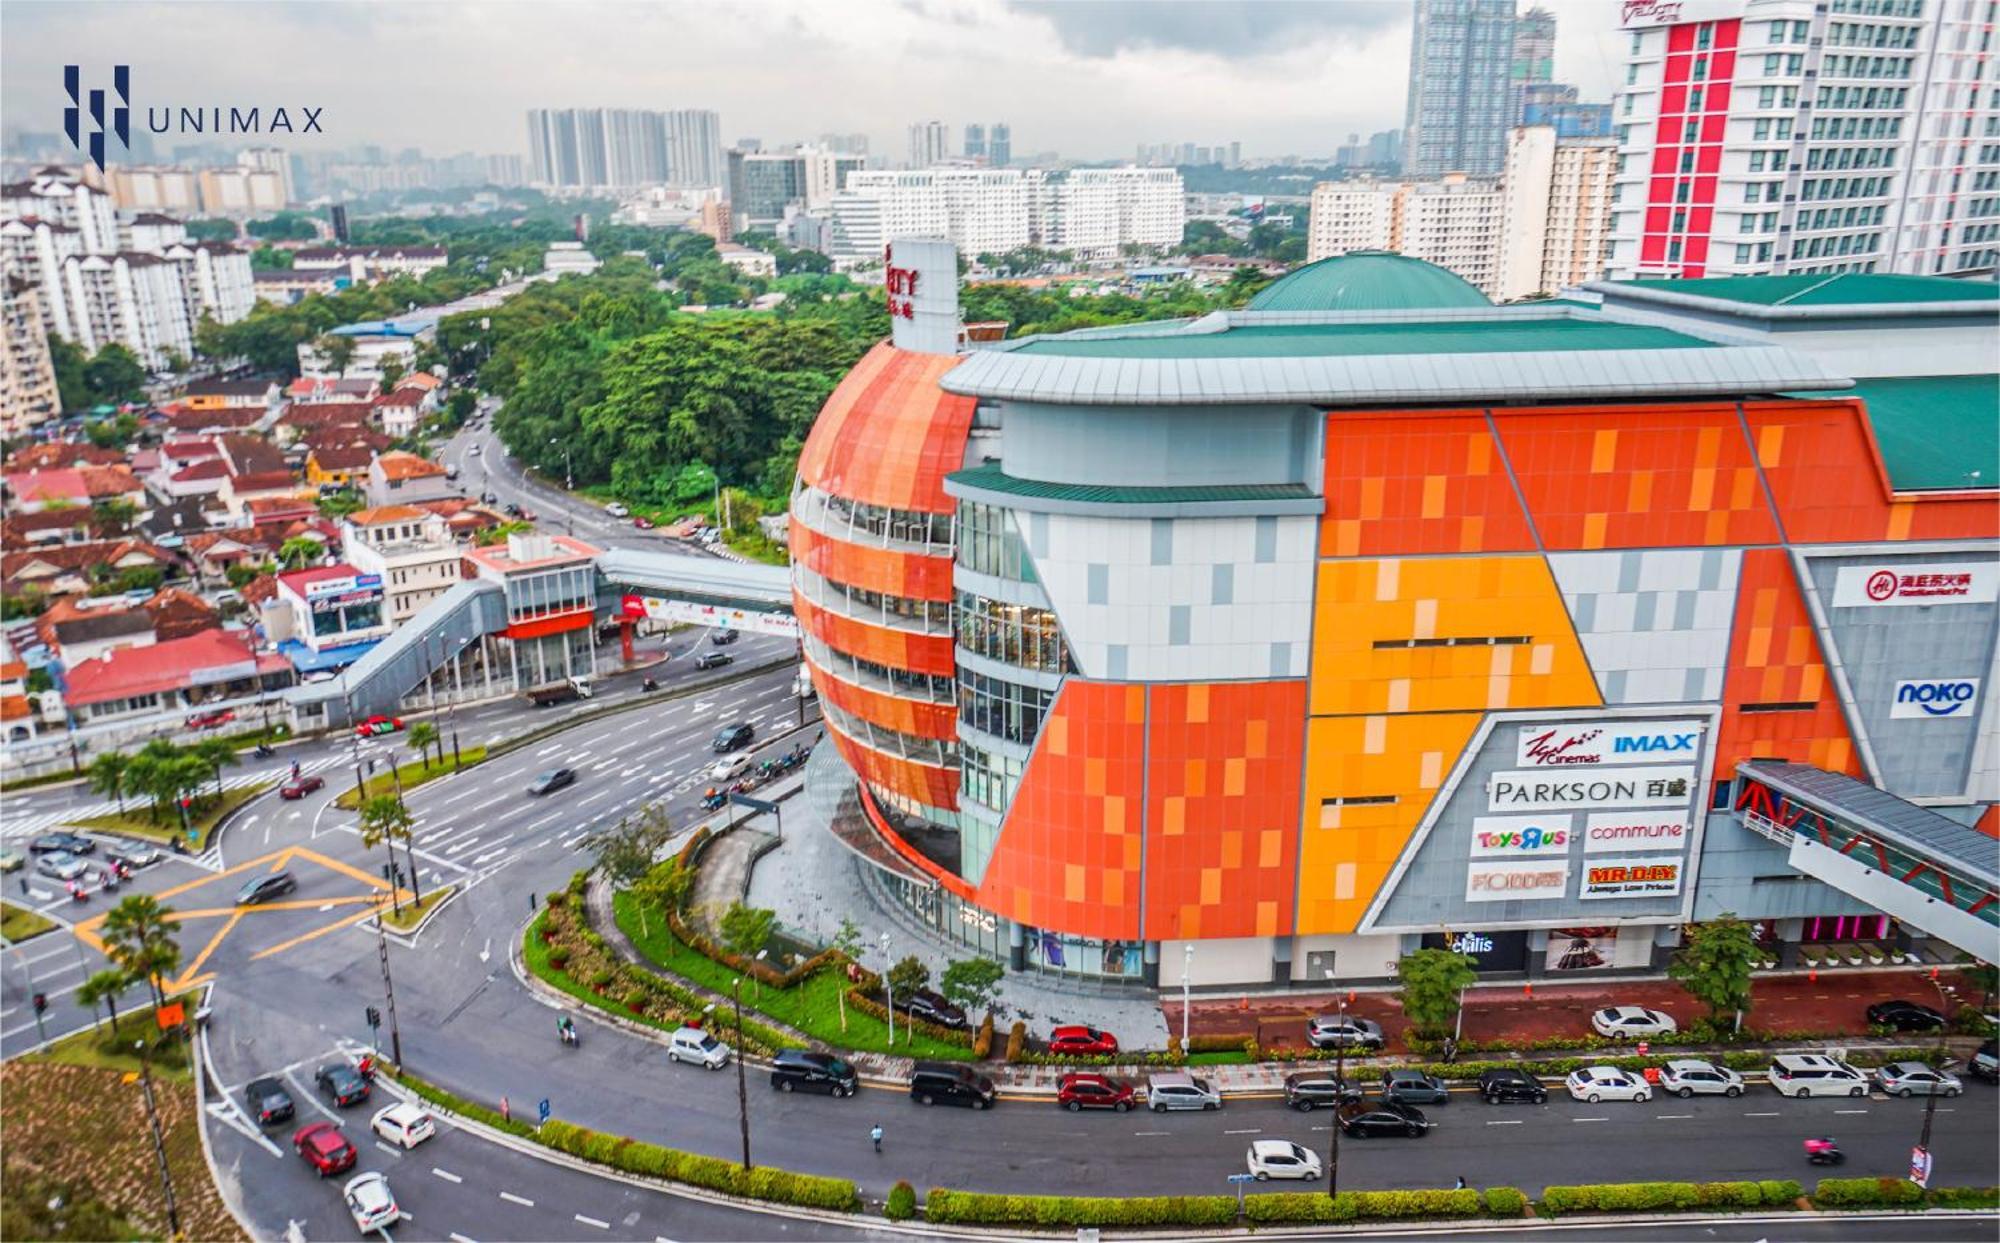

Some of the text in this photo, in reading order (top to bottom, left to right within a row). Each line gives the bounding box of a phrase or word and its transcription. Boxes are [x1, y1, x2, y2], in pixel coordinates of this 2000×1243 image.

[1613, 733, 1697, 753] IMAX
[1547, 754, 1601, 765] Cinemas
[1495, 781, 1636, 803] PARKSON
[1590, 823, 1683, 840] commune
